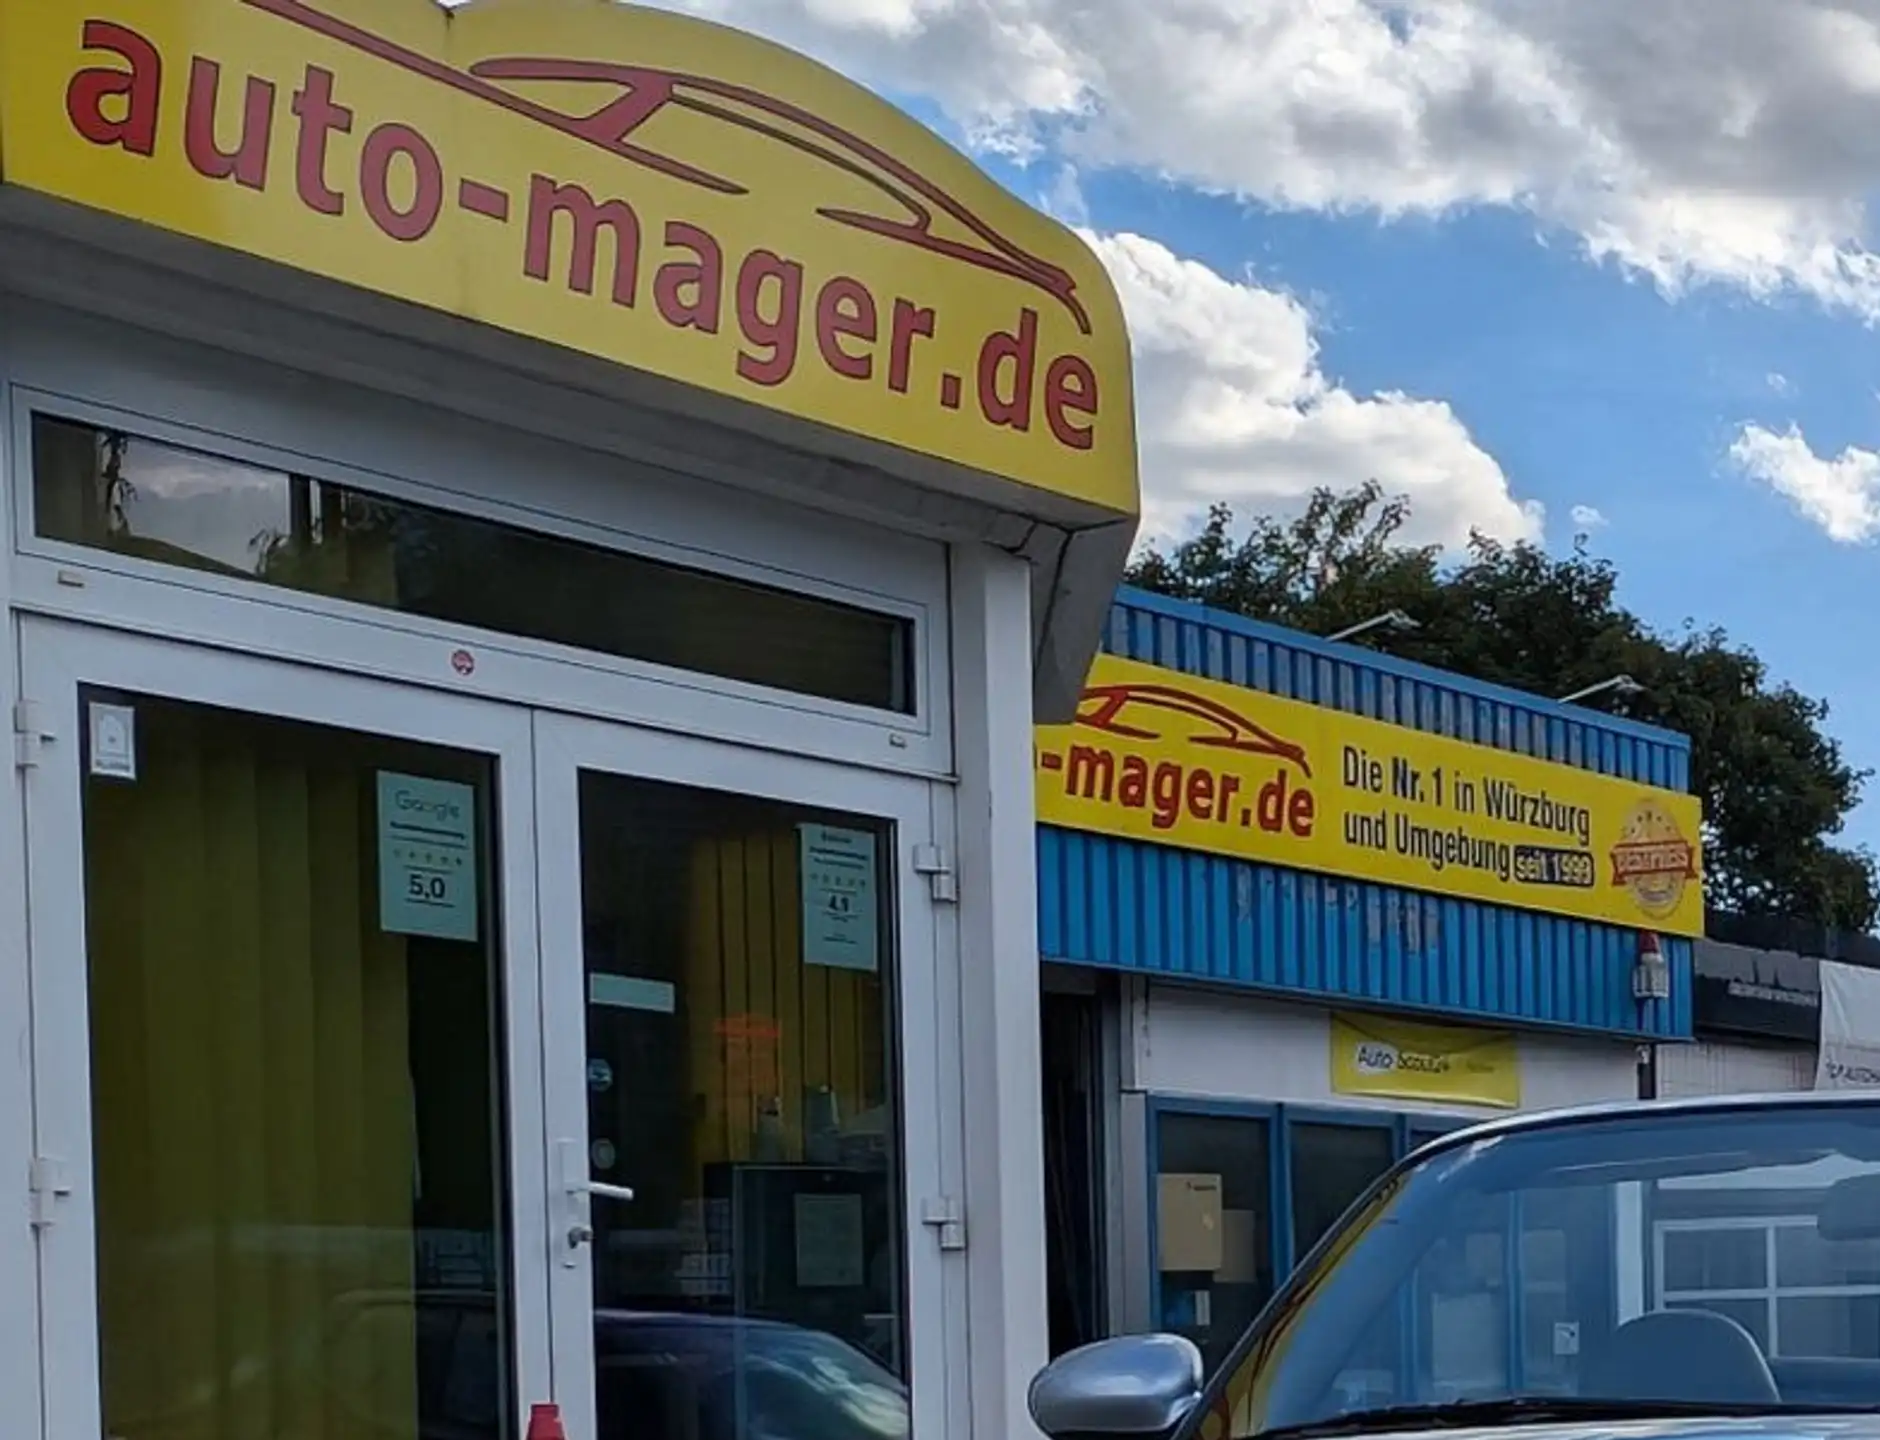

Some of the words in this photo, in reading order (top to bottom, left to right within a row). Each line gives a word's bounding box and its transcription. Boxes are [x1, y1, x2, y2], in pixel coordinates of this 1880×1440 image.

[65, 18, 1099, 452] auto-mager.de
[1035, 742, 1315, 838] -mager.de
[1343, 745, 1384, 794] Die
[1391, 756, 1426, 803] Nr.
[1432, 766, 1443, 807] 1
[1453, 770, 1476, 815] in
[1482, 775, 1591, 847] Würzburg
[1343, 809, 1388, 851] und
[1394, 812, 1512, 883] Umgebung
